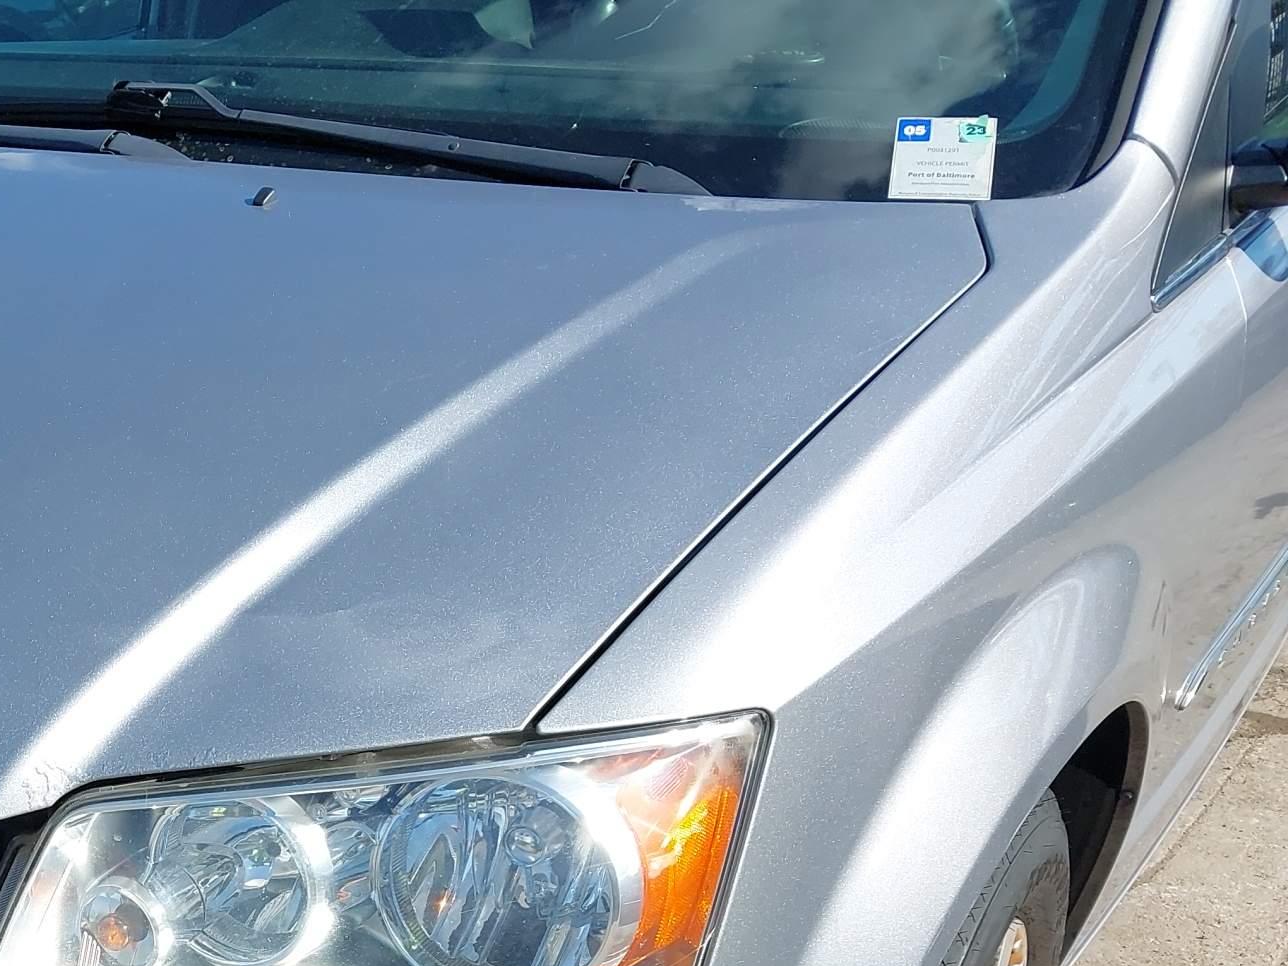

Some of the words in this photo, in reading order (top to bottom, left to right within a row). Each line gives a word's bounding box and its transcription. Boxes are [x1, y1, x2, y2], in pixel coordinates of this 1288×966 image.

[903, 124, 927, 136] 05
[966, 125, 987, 136] 23
[936, 171, 975, 179] Baltimore
